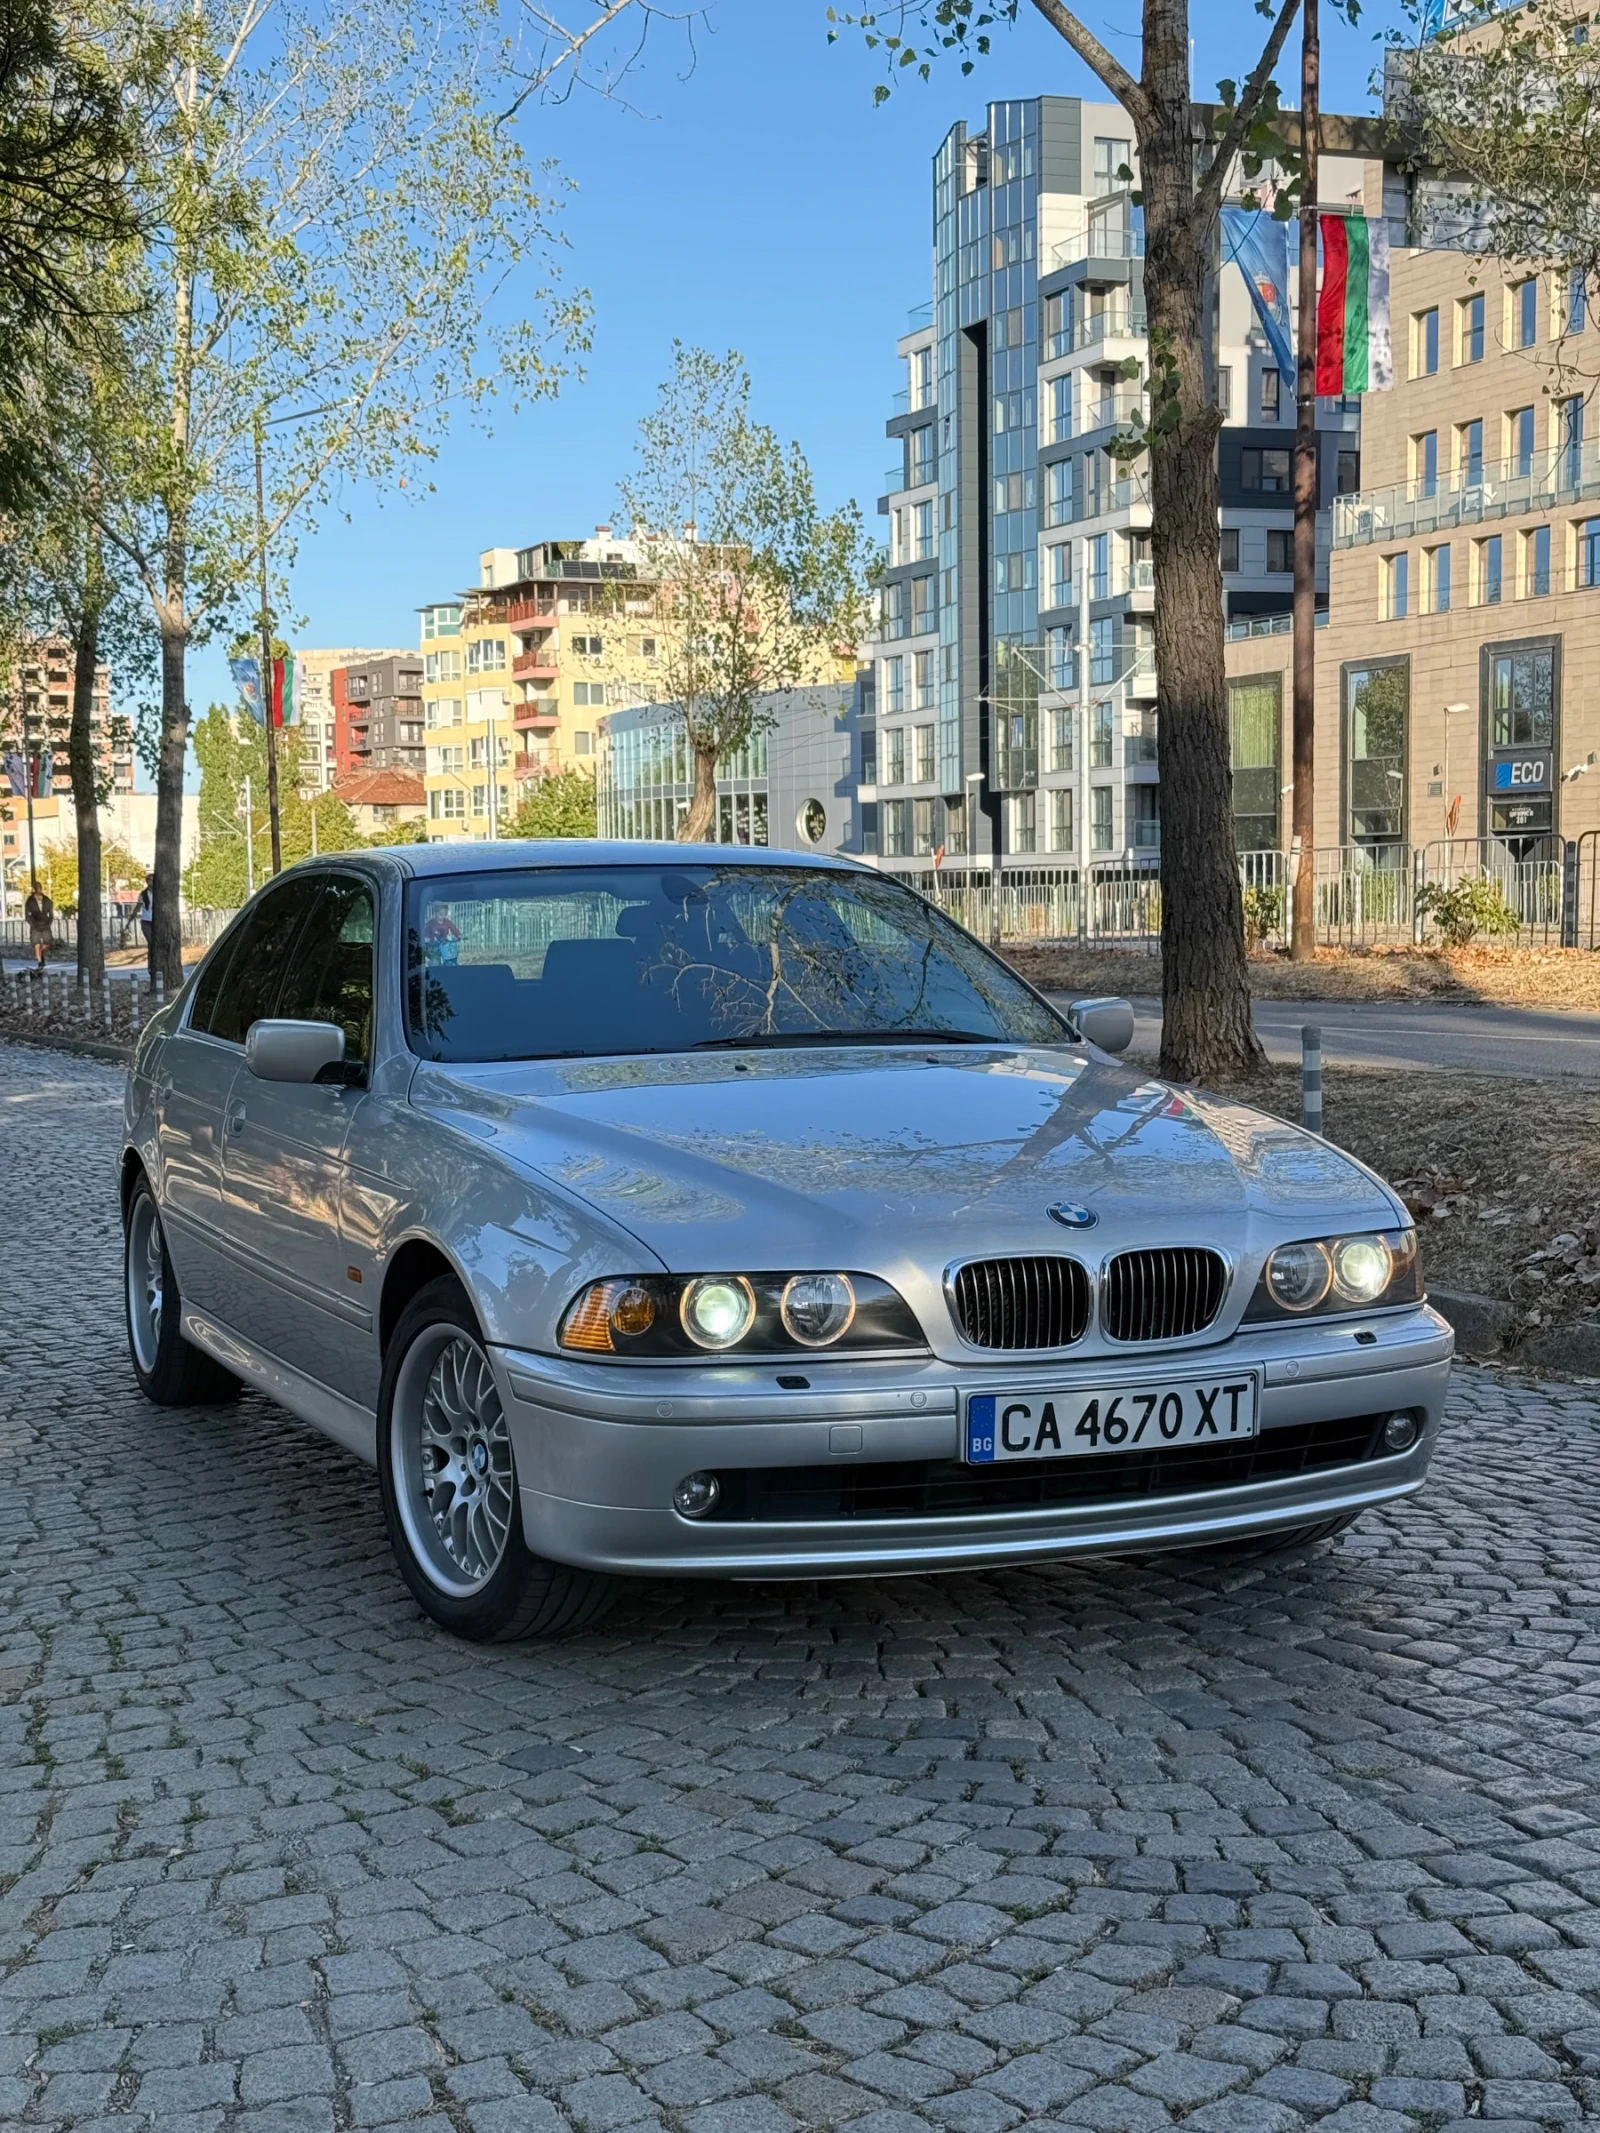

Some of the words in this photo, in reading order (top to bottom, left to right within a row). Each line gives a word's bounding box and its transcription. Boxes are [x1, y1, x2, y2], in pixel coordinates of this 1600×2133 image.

[1511, 761, 1544, 784] ECO
[1001, 1402, 1061, 1452] CA
[1075, 1392, 1183, 1447] 4670
[1193, 1384, 1248, 1436] XT
[972, 1437, 992, 1452] BG
